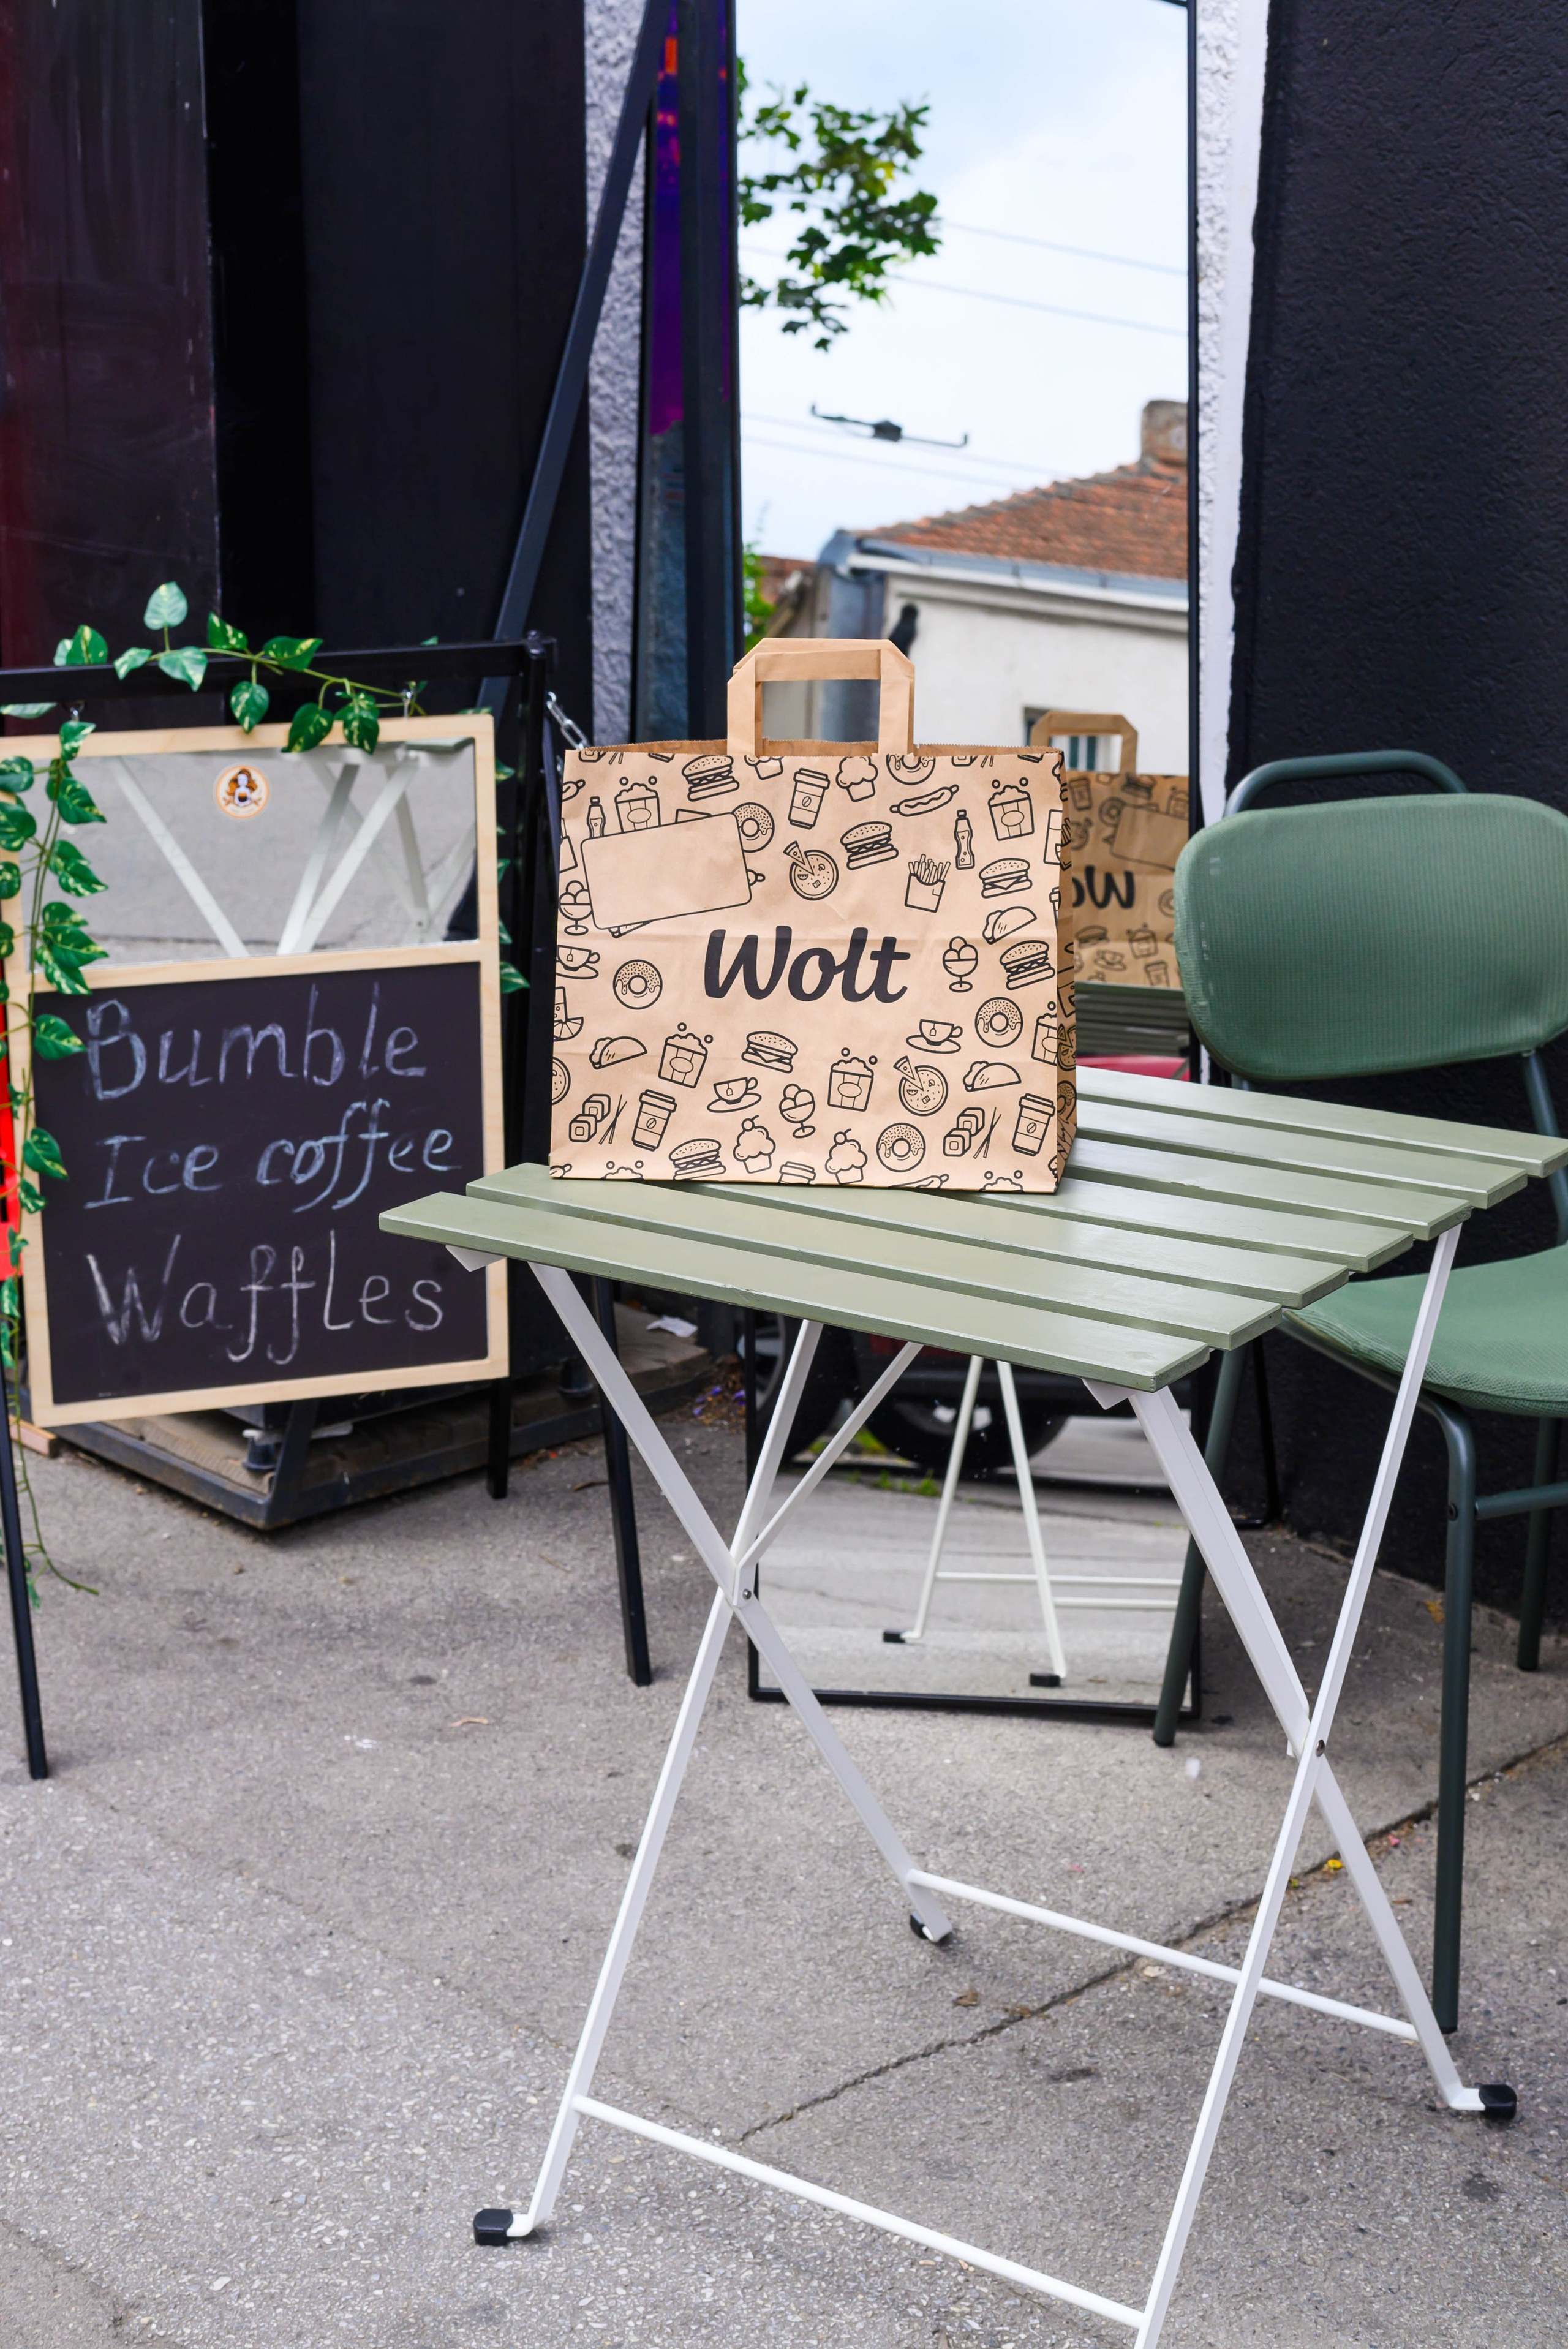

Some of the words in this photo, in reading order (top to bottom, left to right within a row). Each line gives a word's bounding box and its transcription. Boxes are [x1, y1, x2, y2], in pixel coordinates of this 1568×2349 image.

[704, 925, 911, 1003] Wolt
[86, 983, 427, 1101] Bumble
[84, 1135, 223, 1209] Ice
[257, 1098, 464, 1213] coffee
